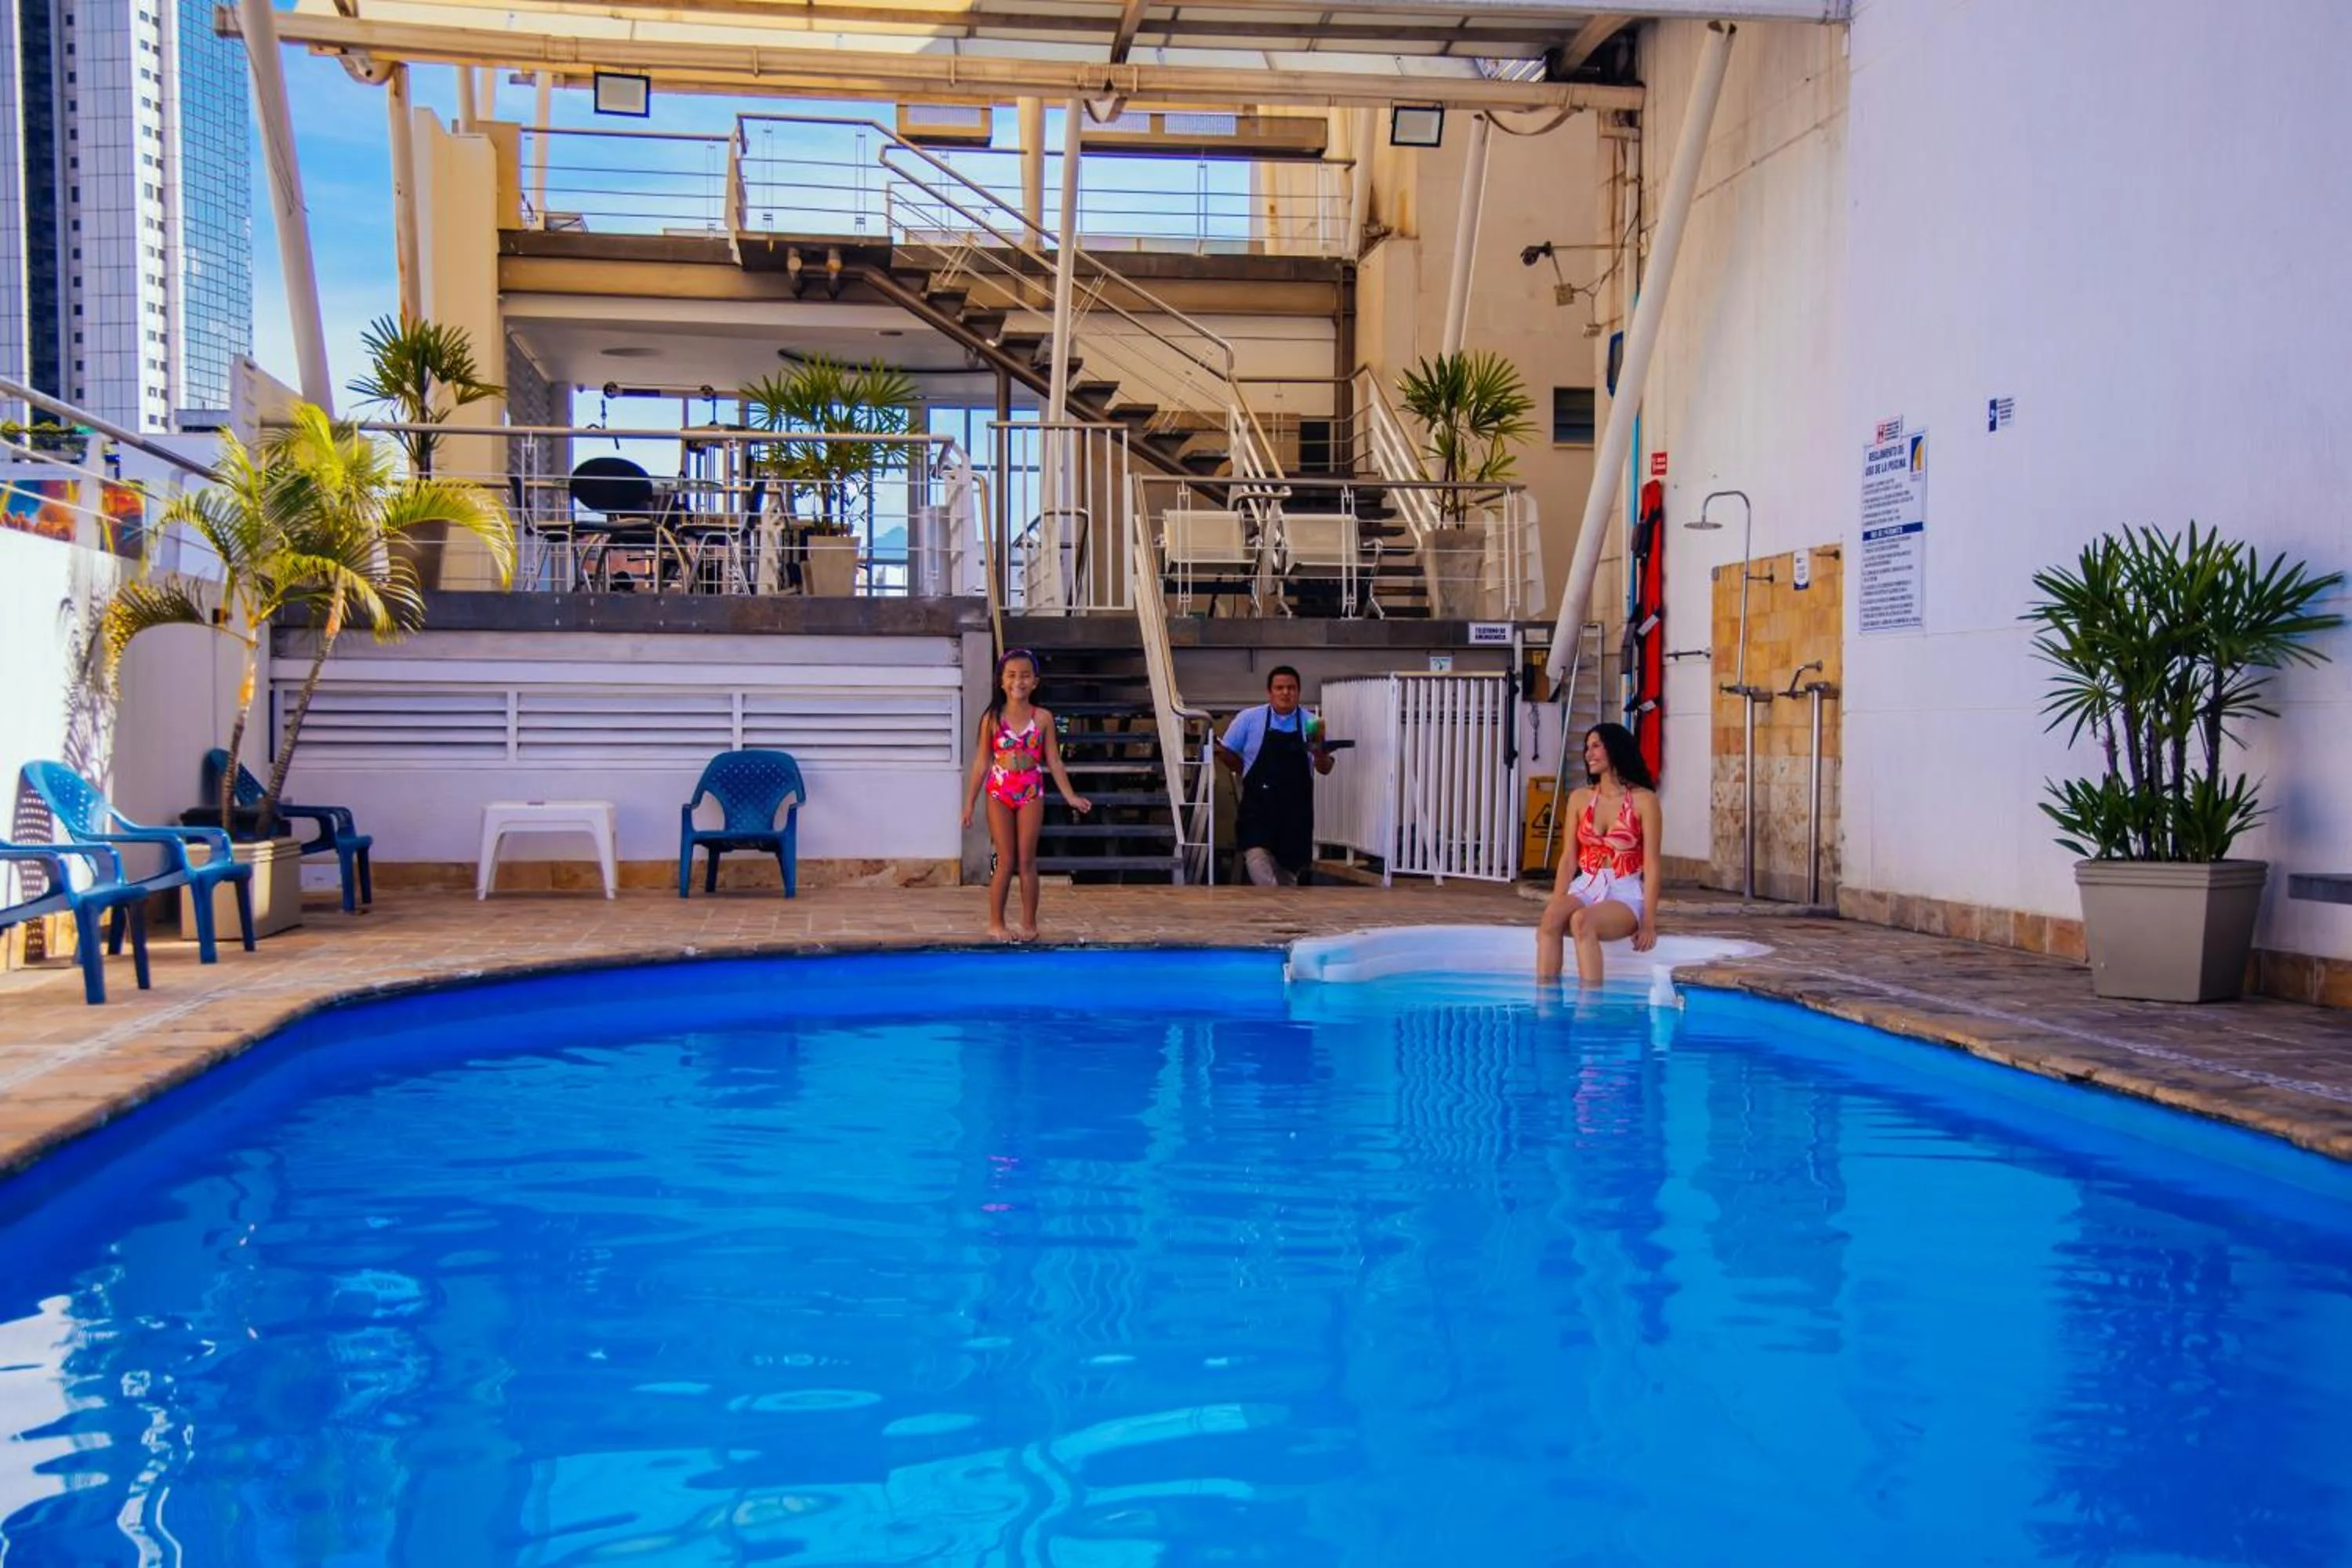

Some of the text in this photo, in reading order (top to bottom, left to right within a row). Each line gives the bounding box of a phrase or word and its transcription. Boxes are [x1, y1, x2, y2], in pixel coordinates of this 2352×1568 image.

[1868, 446, 1897, 462] REGLAMENTO
[1875, 463, 1881, 474] DE
[1882, 461, 1887, 473] LA
[1888, 458, 1906, 471] PISCINA
